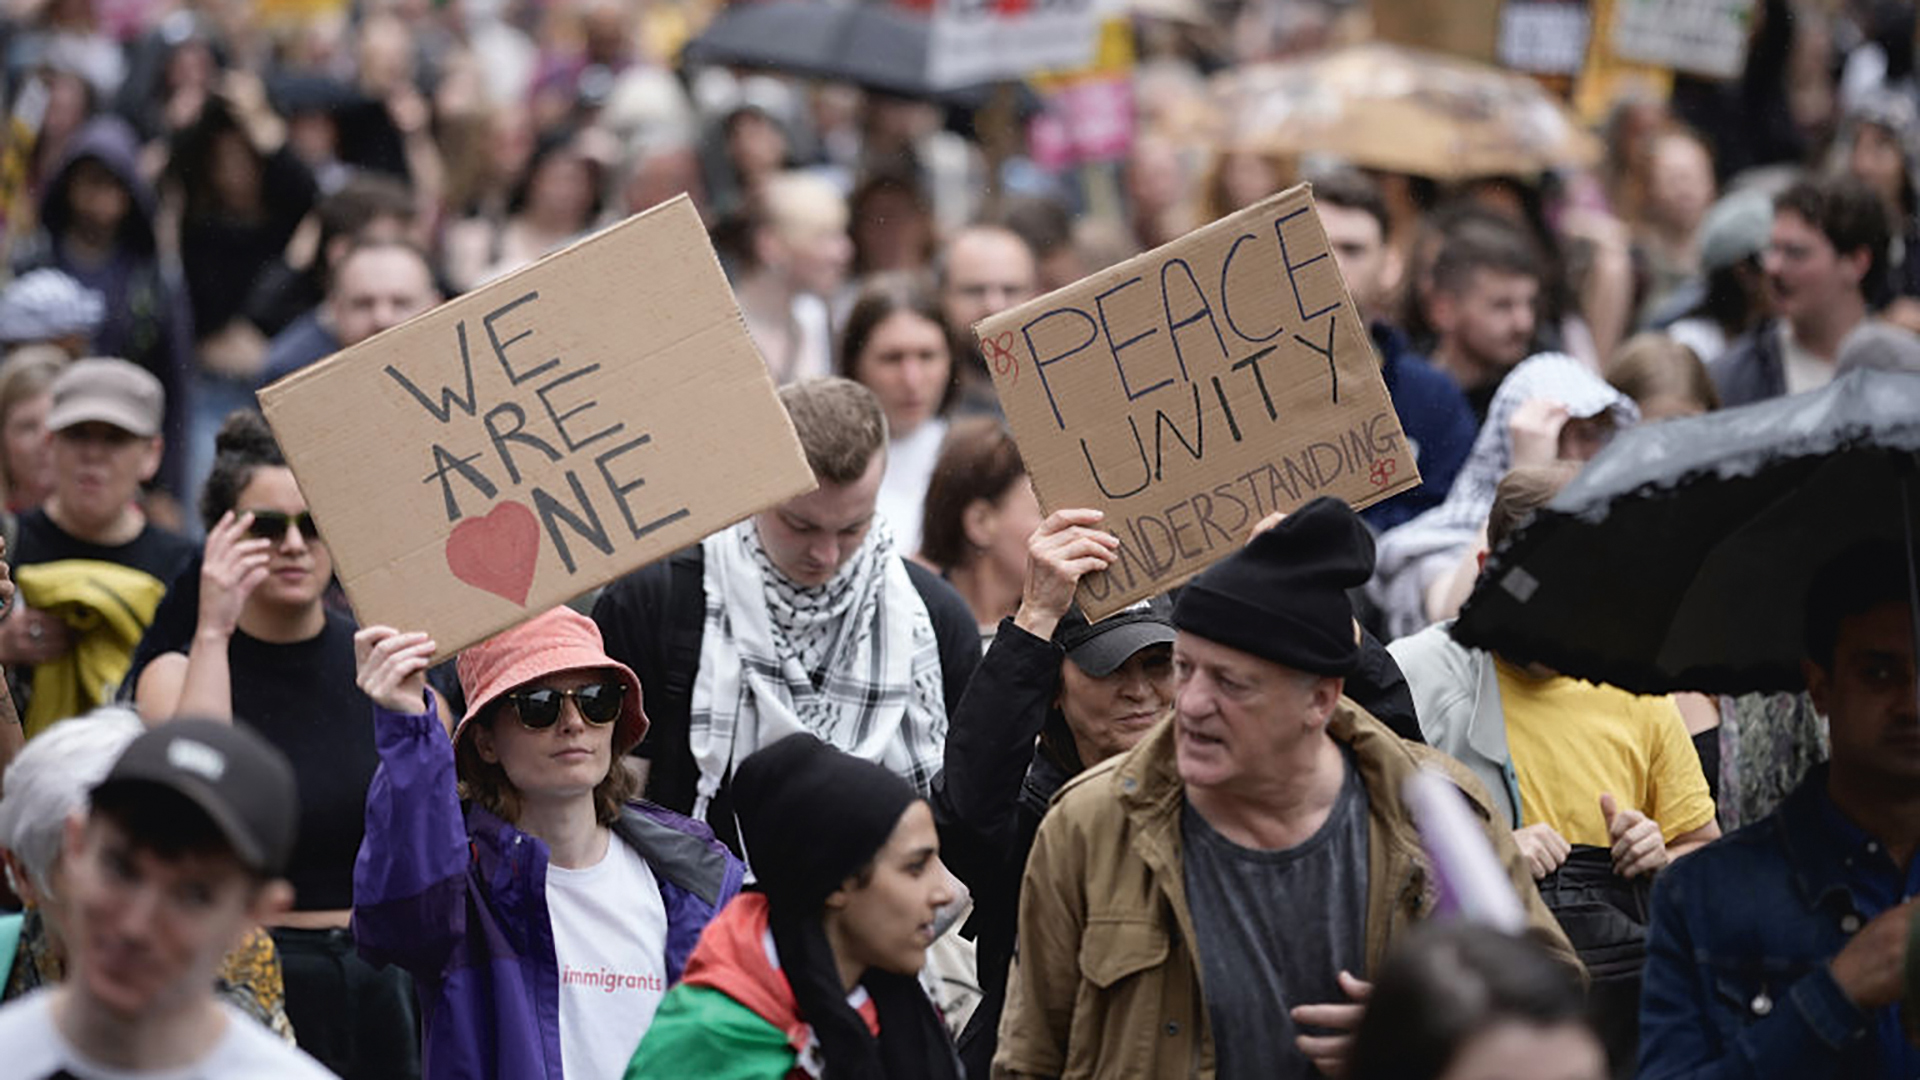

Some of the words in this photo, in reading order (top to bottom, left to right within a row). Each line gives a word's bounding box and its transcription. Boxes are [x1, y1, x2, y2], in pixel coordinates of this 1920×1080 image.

[384, 291, 560, 423] WE
[1022, 207, 1341, 430] PEACE
[422, 364, 624, 521] ARE
[1080, 316, 1338, 499] UNITY
[562, 965, 661, 993] immigrants
